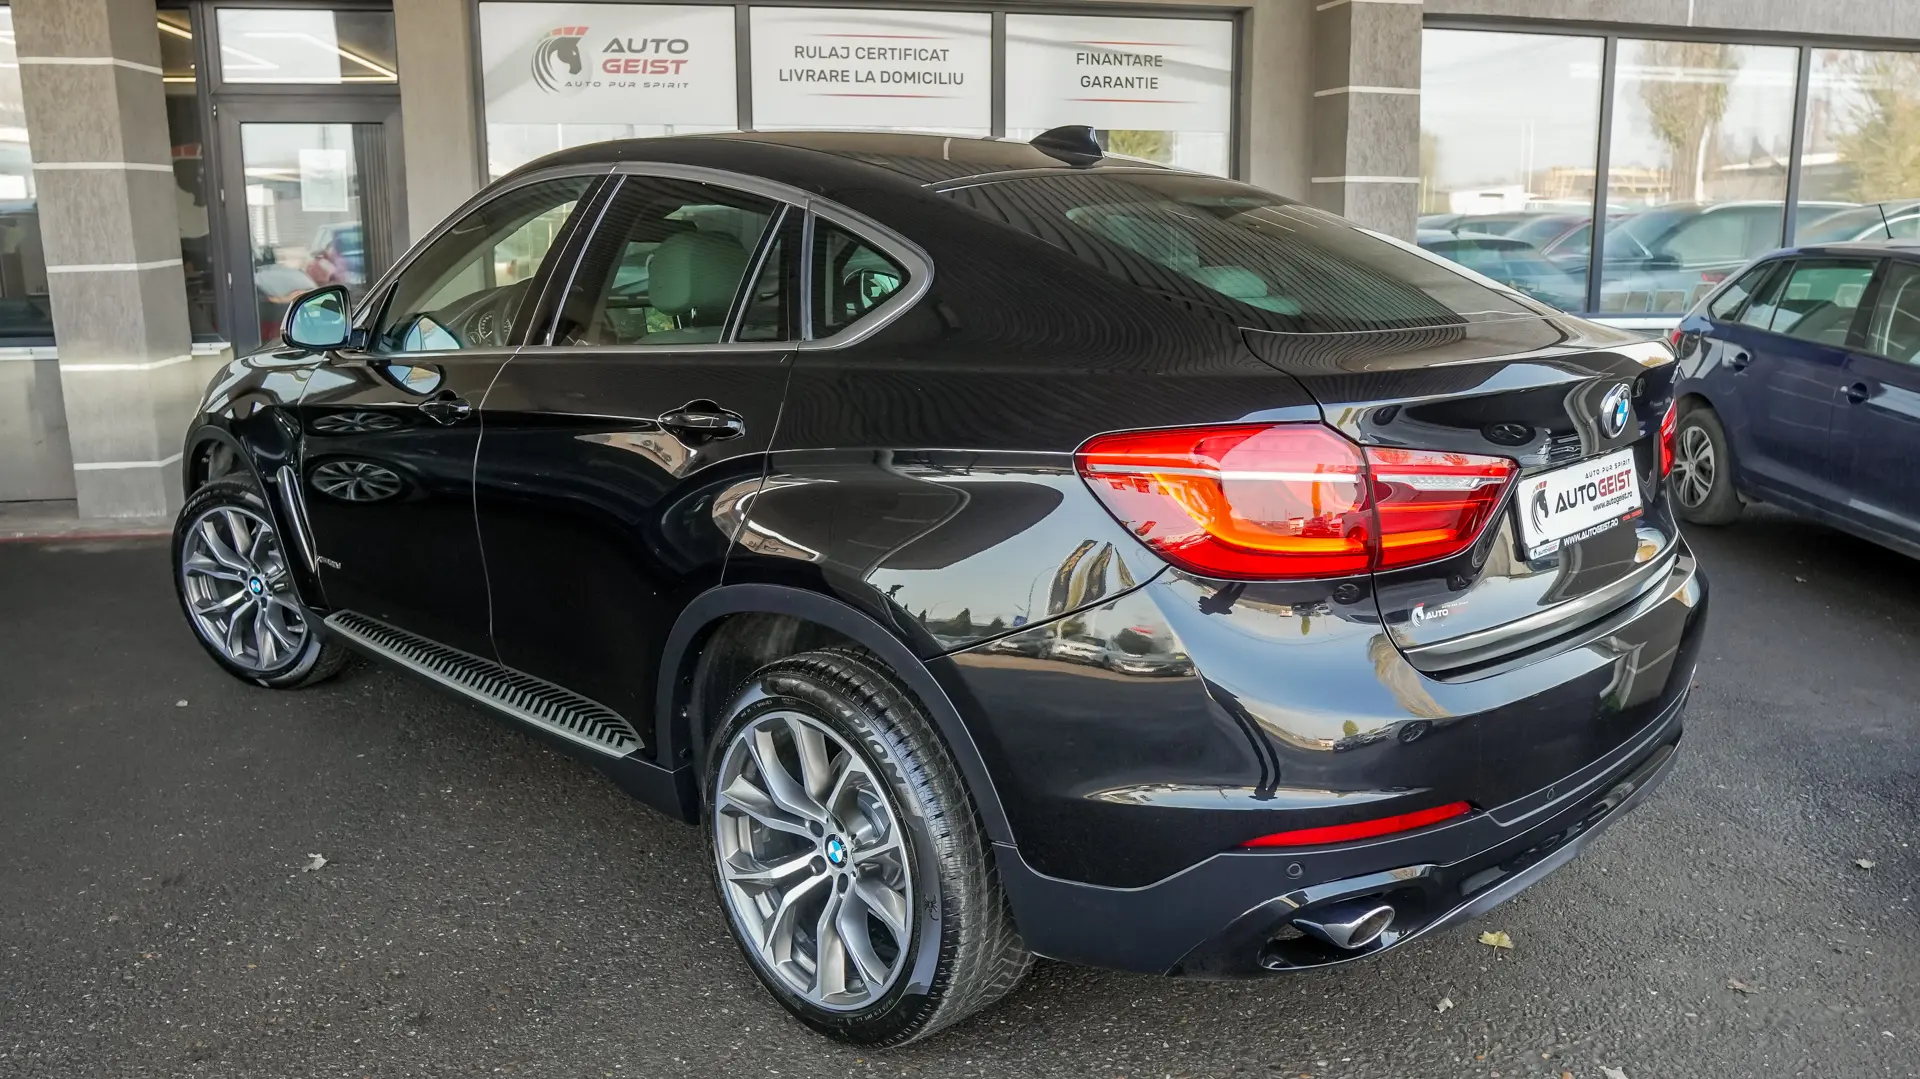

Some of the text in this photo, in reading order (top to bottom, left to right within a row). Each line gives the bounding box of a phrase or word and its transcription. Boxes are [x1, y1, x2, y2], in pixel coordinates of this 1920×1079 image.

[602, 37, 689, 54] AUTO
[794, 45, 949, 62] RULAJ CERTIFICAT
[602, 58, 689, 75] GEIST
[1076, 52, 1163, 68] FINANTARE
[779, 68, 964, 85] LIVRARE LA DOMICILIU
[1080, 75, 1159, 90] GARANTIE
[1585, 458, 1631, 479] AUTO PUR SPIRIT
[1555, 469, 1631, 514] AUTOGEIST
[1592, 491, 1633, 512] www.autogeist.ro
[1563, 518, 1619, 547] WWW.AUTOGEIST.RO
